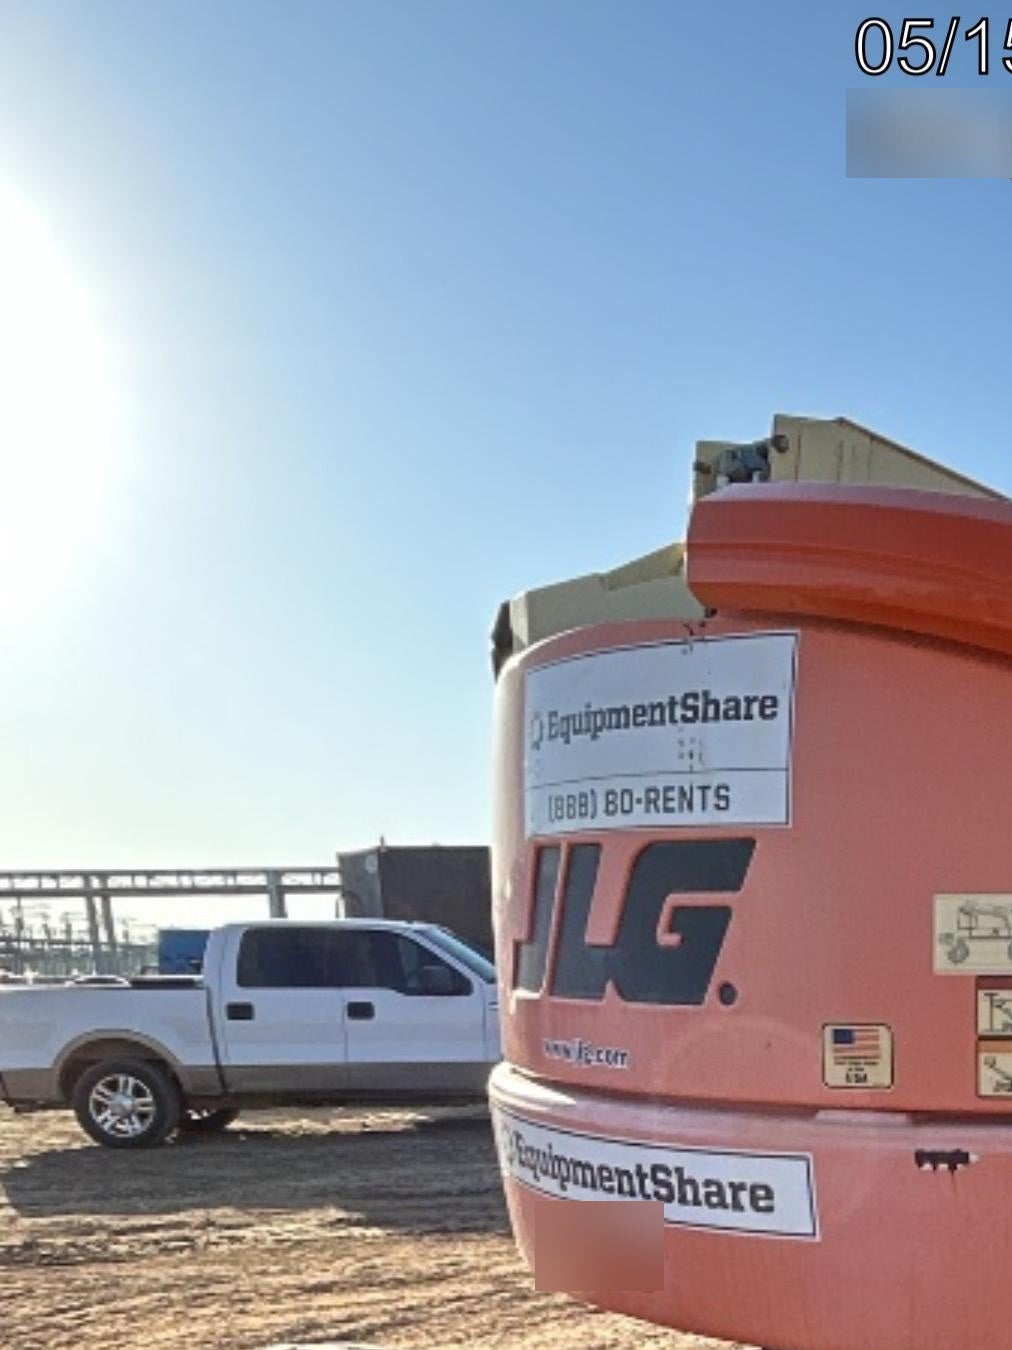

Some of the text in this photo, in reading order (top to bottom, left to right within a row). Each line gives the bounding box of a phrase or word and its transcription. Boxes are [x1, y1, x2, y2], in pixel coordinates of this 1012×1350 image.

[547, 689, 779, 745] EquipmentShare
[512, 836, 757, 1006] JLG
[512, 1130, 776, 1214] EquipmentShare
